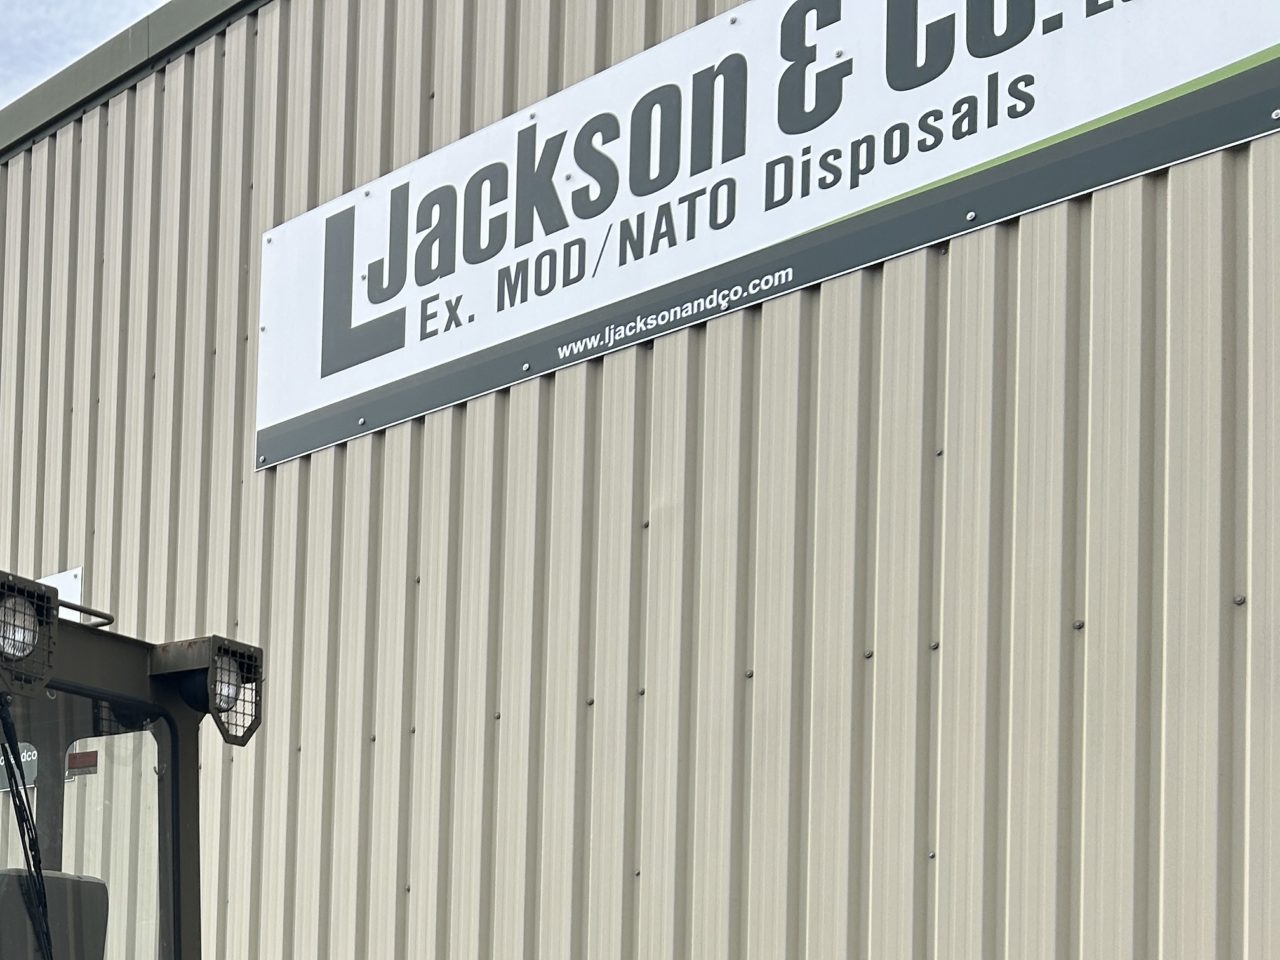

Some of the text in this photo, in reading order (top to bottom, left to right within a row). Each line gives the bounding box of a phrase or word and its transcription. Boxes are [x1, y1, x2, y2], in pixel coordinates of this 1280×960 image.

[777, 0, 853, 135] &
[420, 71, 1036, 341] Ex. MOD/NATO Disposals
[557, 267, 794, 359] www.ljacksonandco.com
